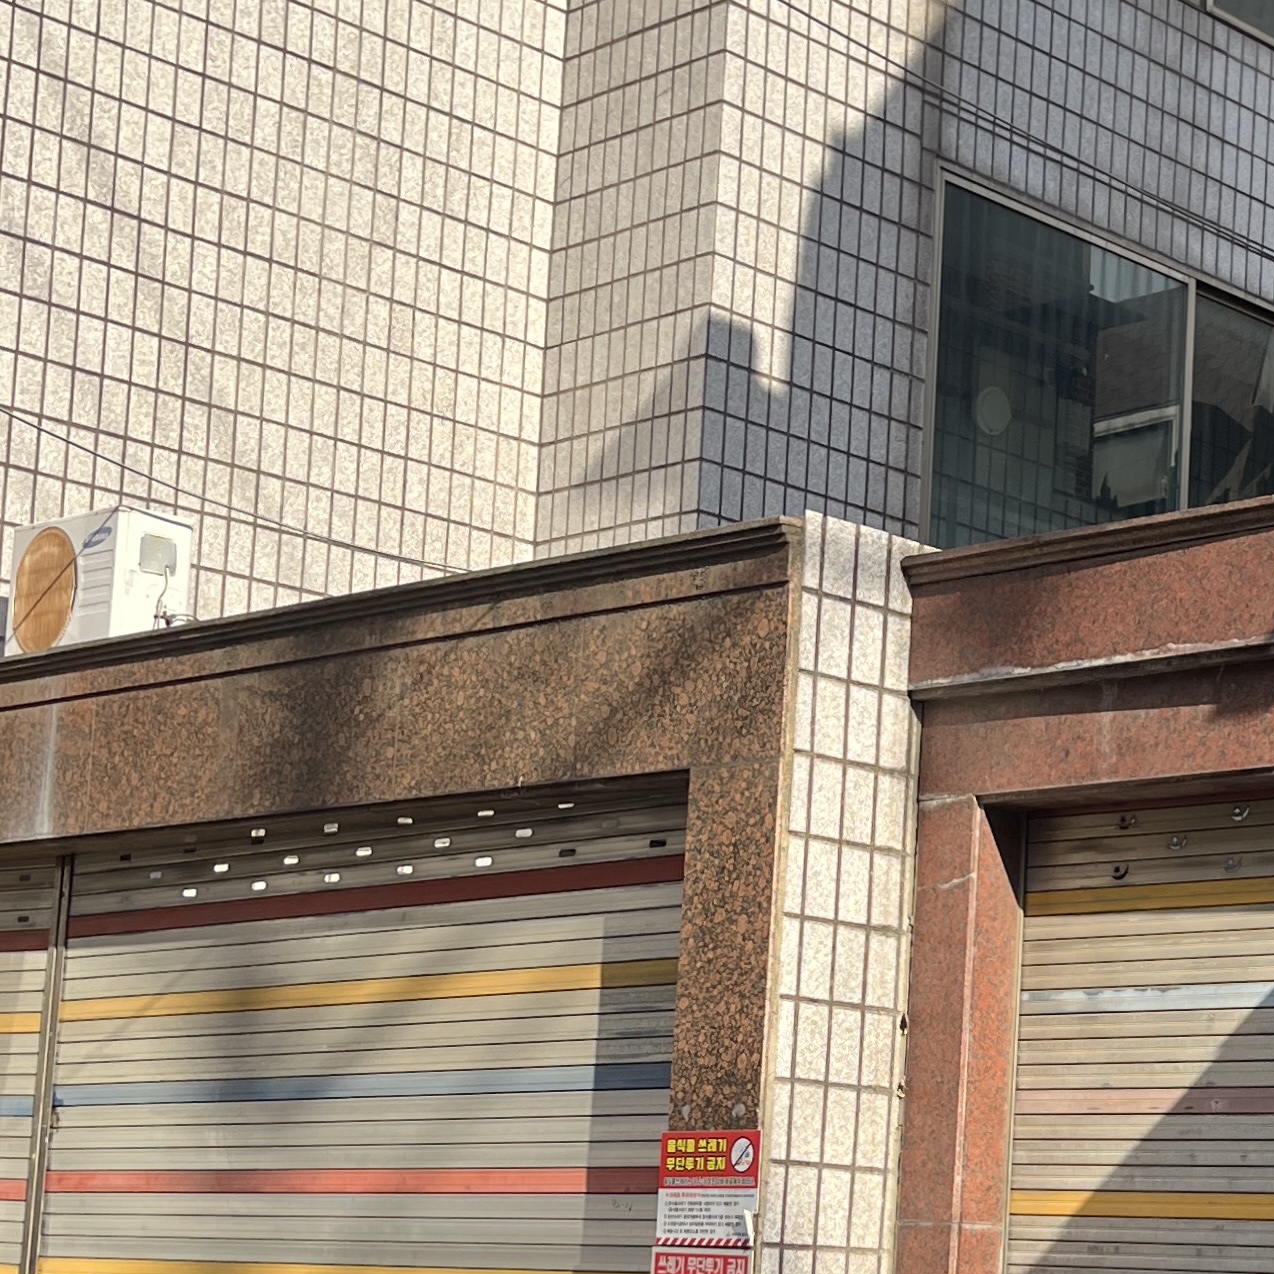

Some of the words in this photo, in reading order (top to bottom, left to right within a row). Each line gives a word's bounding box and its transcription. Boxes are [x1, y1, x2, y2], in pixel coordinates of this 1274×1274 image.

[697, 1138, 728, 1153] 쓰레기
[665, 1156, 705, 1171] 무단투기
[706, 1156, 727, 1171] 금지
[657, 1255, 686, 1274] 쓰레기
